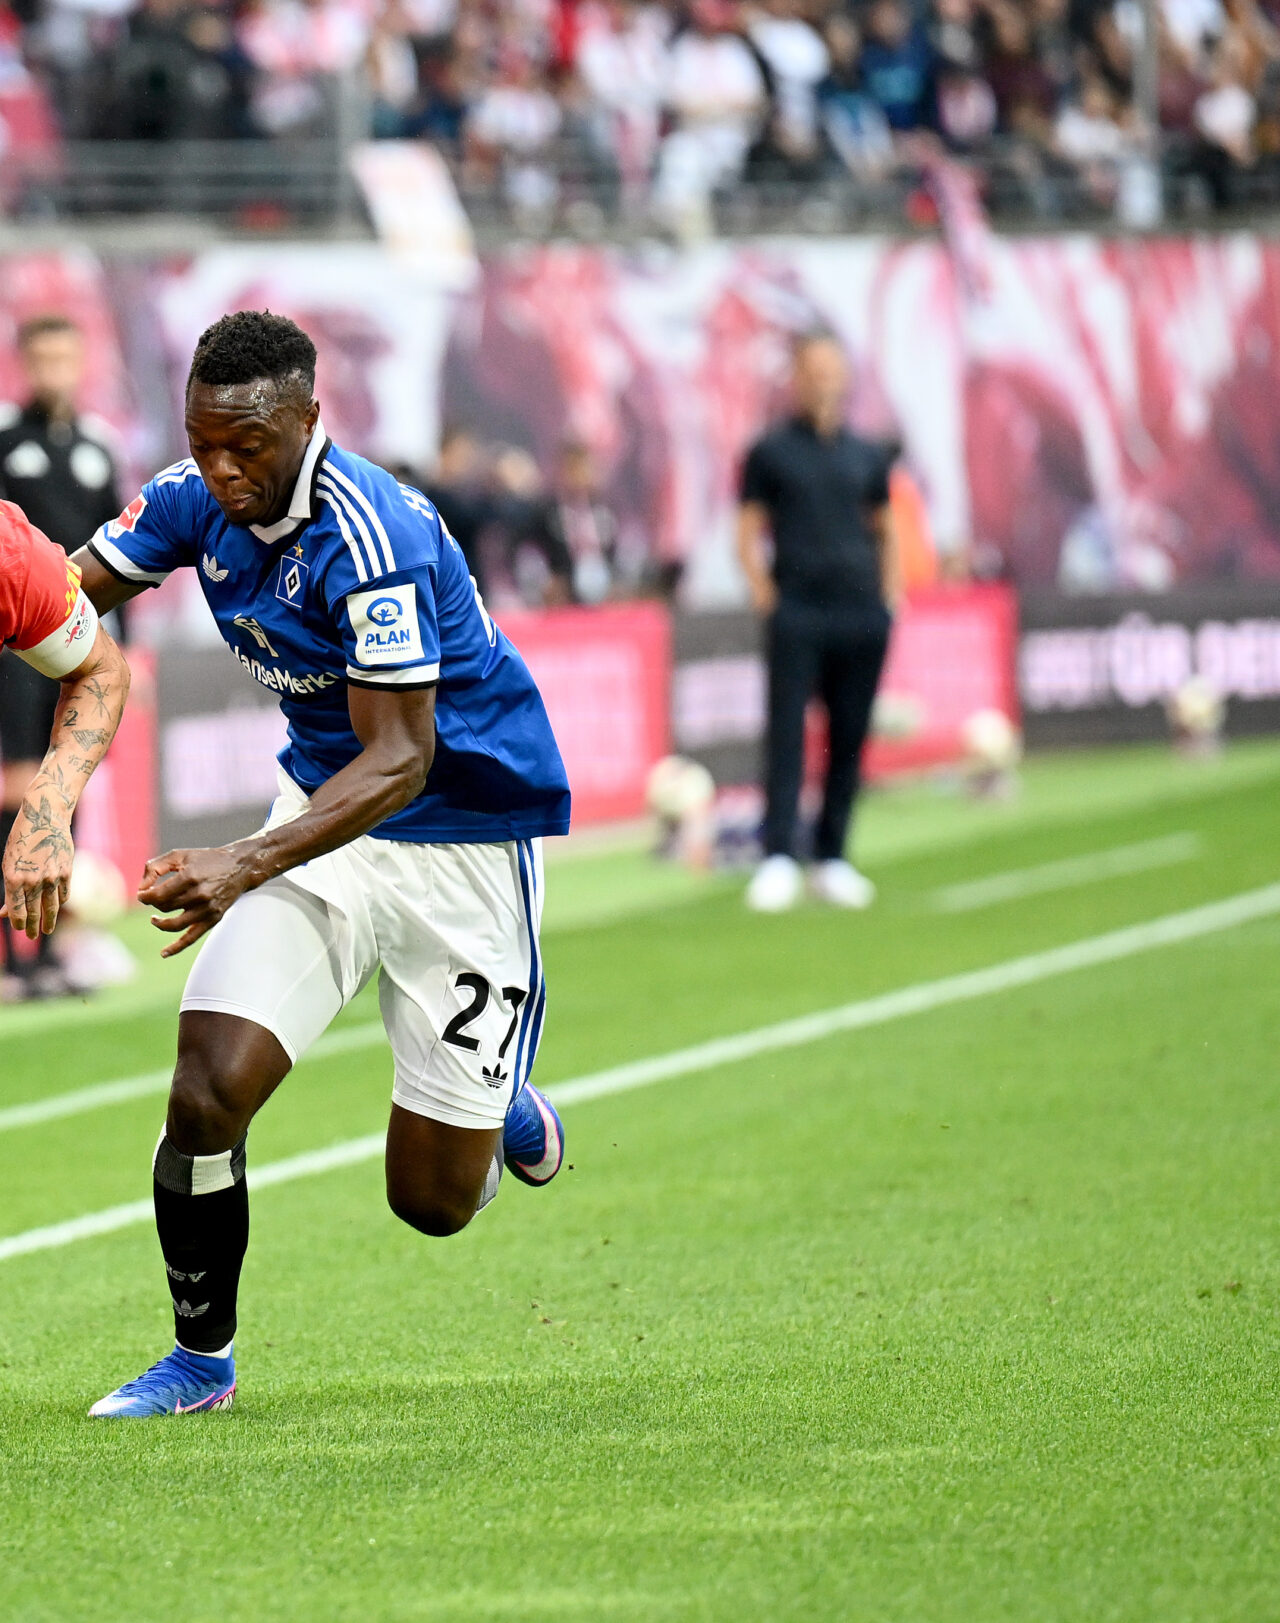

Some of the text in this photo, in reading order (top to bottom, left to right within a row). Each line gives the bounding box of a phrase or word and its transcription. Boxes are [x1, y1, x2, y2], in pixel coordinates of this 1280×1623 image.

[364, 628, 411, 647] PLAN
[365, 645, 412, 655] INTERNATIONAL
[441, 972, 528, 1060] 27
